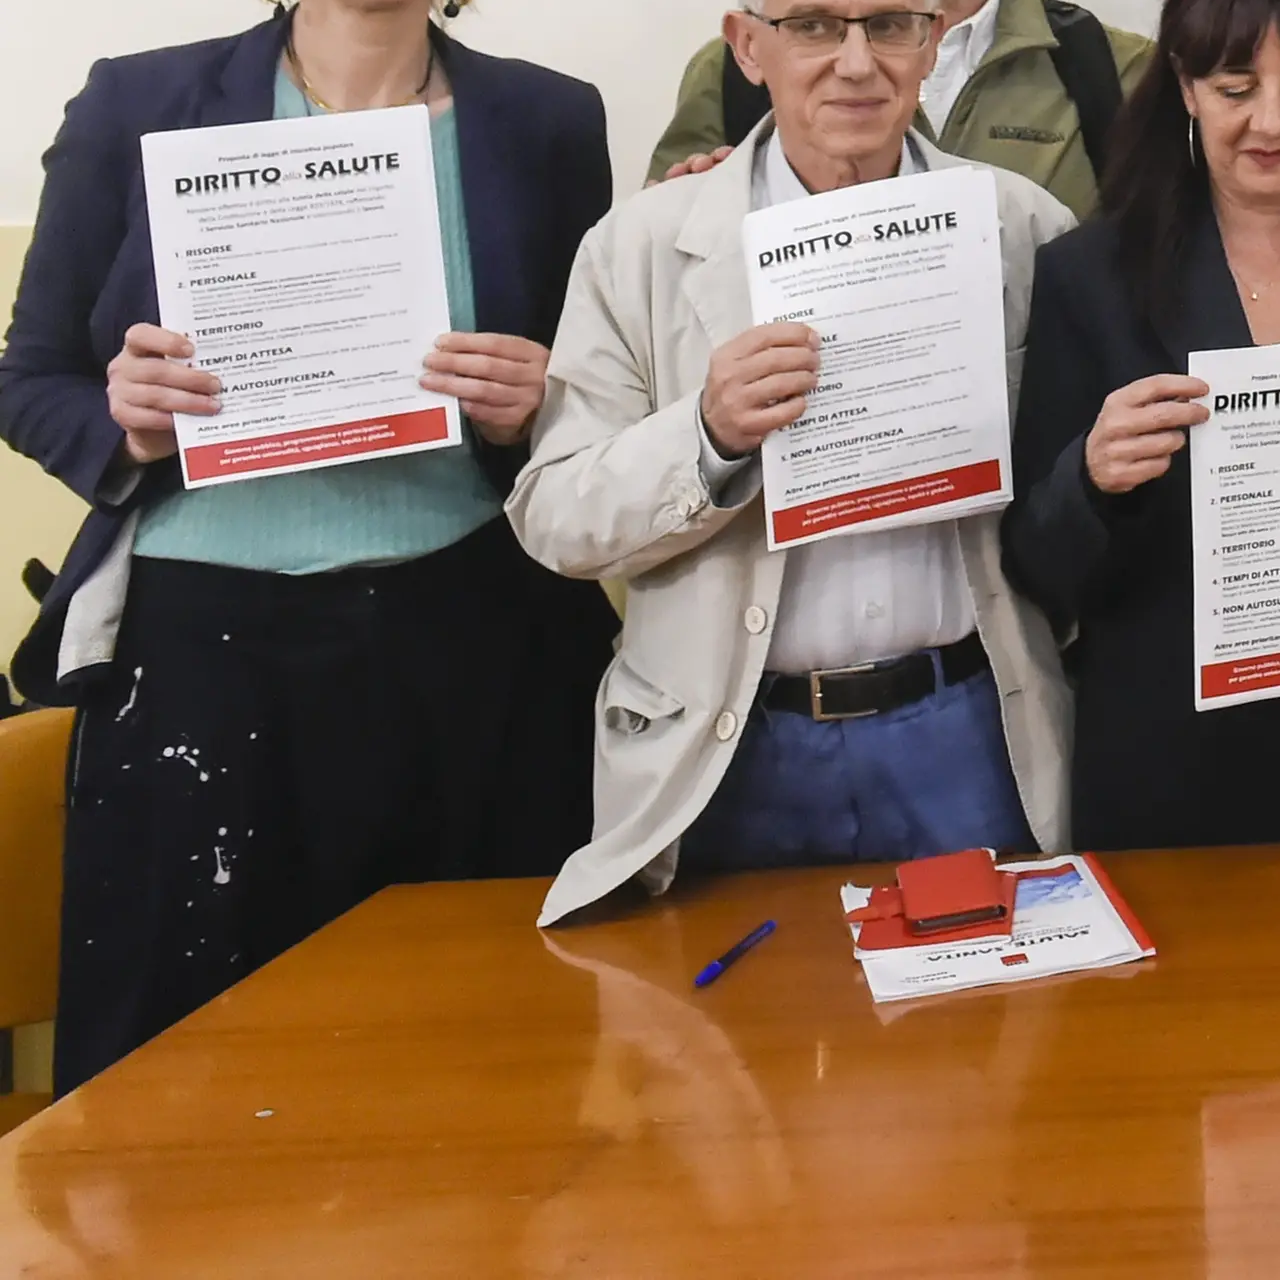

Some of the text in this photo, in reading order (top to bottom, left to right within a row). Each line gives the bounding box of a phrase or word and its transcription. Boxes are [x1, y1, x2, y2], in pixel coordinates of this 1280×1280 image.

[175, 167, 281, 194] DIRITTO
[304, 152, 400, 179] SALUTE
[758, 231, 852, 267] DIRITTO
[873, 211, 957, 240] SALUTE
[185, 244, 232, 256] RISORSE
[190, 271, 257, 286] PERSONALE
[772, 307, 814, 325] RISORSE
[195, 320, 264, 336] TERRITORIO
[199, 355, 233, 366] TEMPI
[235, 353, 248, 361] DI
[250, 346, 293, 358] ATTESA
[231, 369, 335, 392] AUTOSUFFICIENZA
[787, 406, 868, 429] TEMPI DI ATTESA
[790, 448, 812, 458] NON
[814, 427, 904, 452] AUTOSUFFICIENZA
[1218, 461, 1255, 473] RISORSE
[784, 486, 804, 495] Altre
[804, 482, 821, 490] aree
[1219, 489, 1273, 503] PERSONALE
[1221, 539, 1276, 554] TERRITORIO
[1222, 573, 1250, 583] TEMPI
[1251, 571, 1261, 579] DI
[1222, 604, 1245, 613] NON
[1014, 929, 1090, 948] SALUTE
